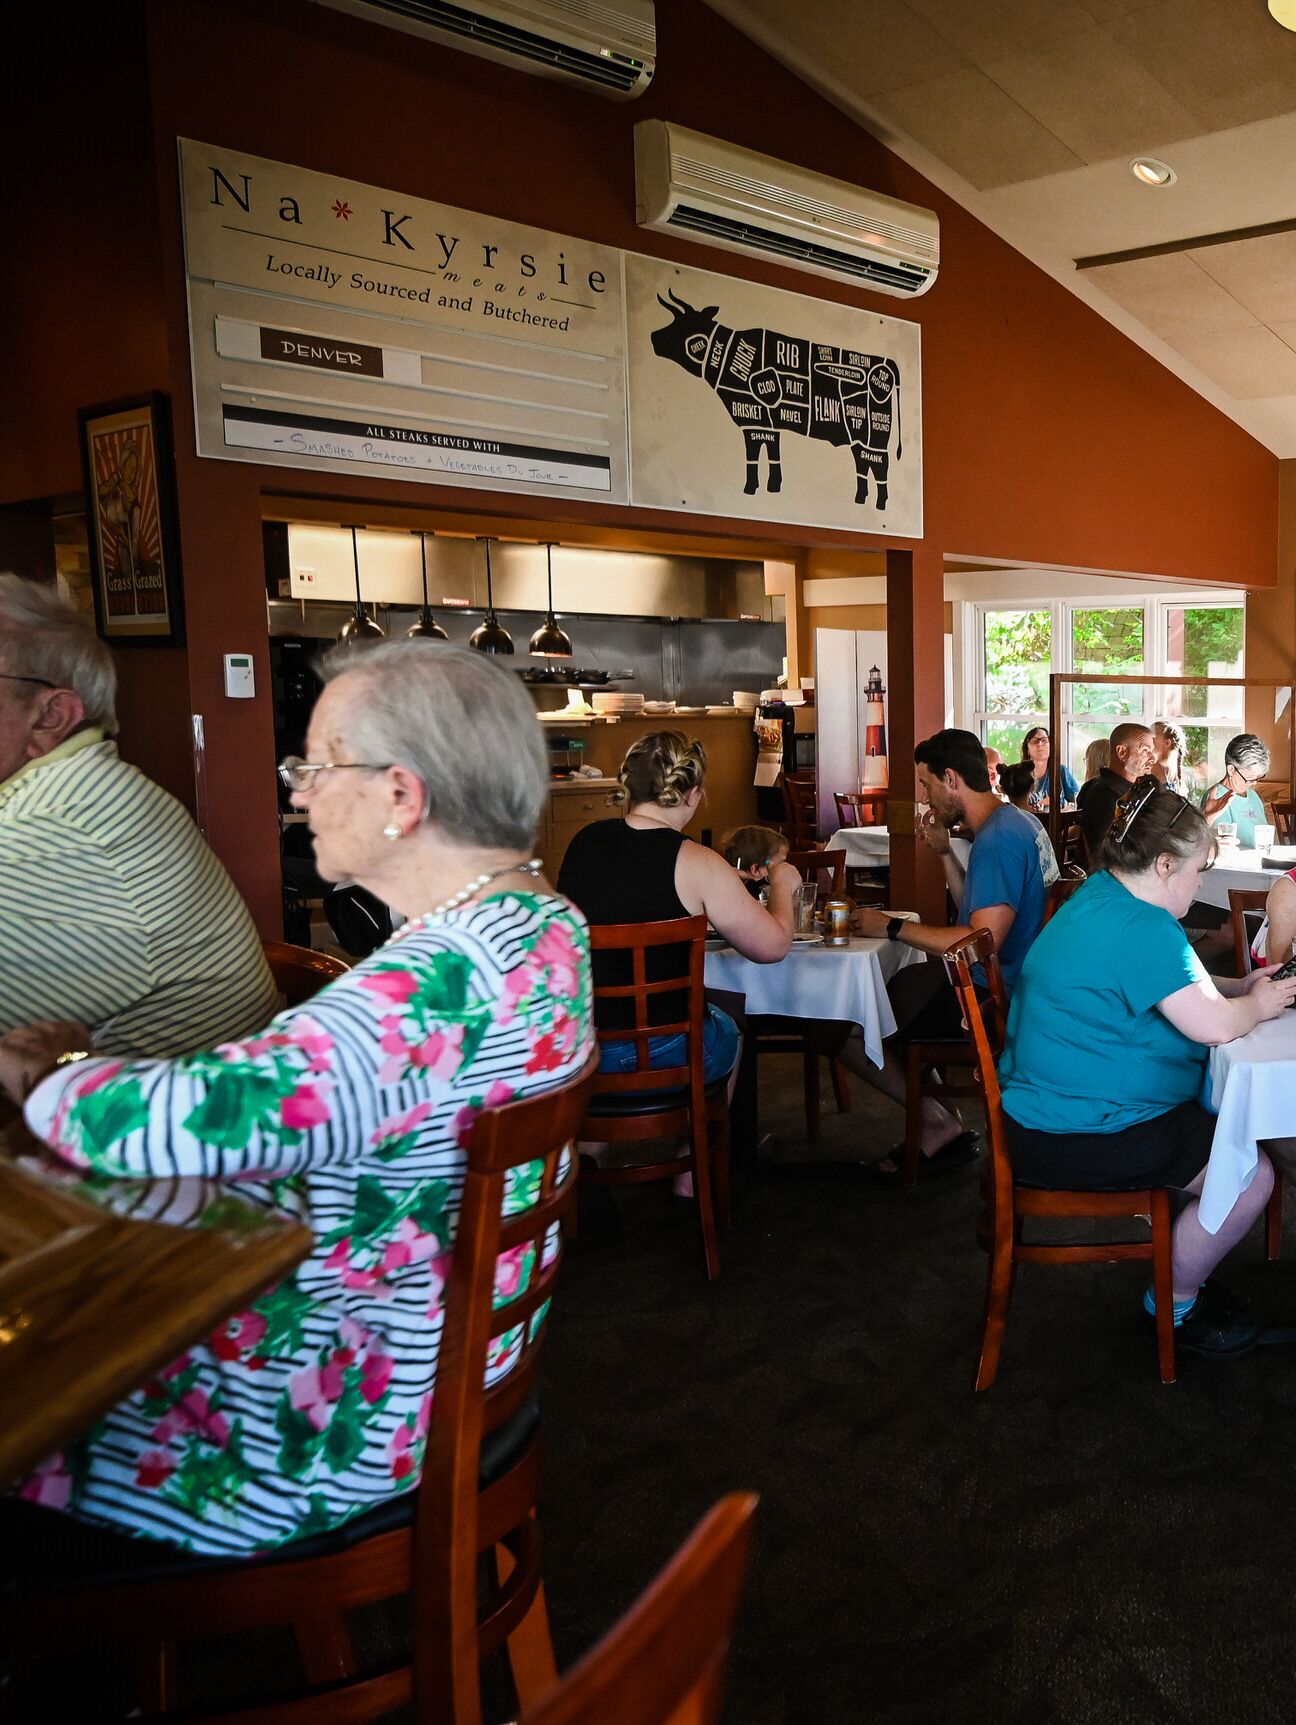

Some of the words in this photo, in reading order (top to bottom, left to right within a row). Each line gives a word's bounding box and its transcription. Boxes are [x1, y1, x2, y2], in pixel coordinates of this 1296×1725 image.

[208, 166, 303, 225] Na
[380, 209, 606, 293] Kyrsie
[266, 255, 342, 289] Locally
[350, 273, 431, 303] Sourced
[438, 296, 473, 312] and
[483, 301, 570, 331] Butchered
[442, 271, 547, 300] meats
[280, 341, 362, 366] DENVER
[710, 341, 724, 368] NECK
[729, 338, 757, 382] CHUCK
[776, 340, 799, 368] RIB
[820, 353, 833, 361] LOIN
[849, 353, 871, 368] SIRLOIN
[828, 366, 861, 379] TENDERLOIN
[879, 369, 889, 381] TOP
[757, 380, 776, 395] CLOD
[786, 380, 803, 397] PLATE
[871, 375, 890, 392] ROUND
[732, 402, 762, 420] BRISKET
[780, 409, 802, 423] NAVEL
[815, 396, 840, 423] FLANK
[846, 405, 866, 419] SIRLOIN
[871, 412, 890, 424] OUTSIDE
[851, 418, 862, 429] TIP
[872, 422, 890, 432] ROUND
[367, 427, 386, 438] ALL
[390, 430, 428, 443] STEAKS
[431, 435, 470, 449] SERVED
[473, 441, 500, 453] WITH
[751, 433, 775, 442] SHANK
[290, 433, 355, 458] SMASHED
[440, 455, 503, 474] VEGETABLES
[860, 450, 883, 463] SHANK
[107, 572, 133, 592] Grass
[134, 570, 163, 589] Grazed
